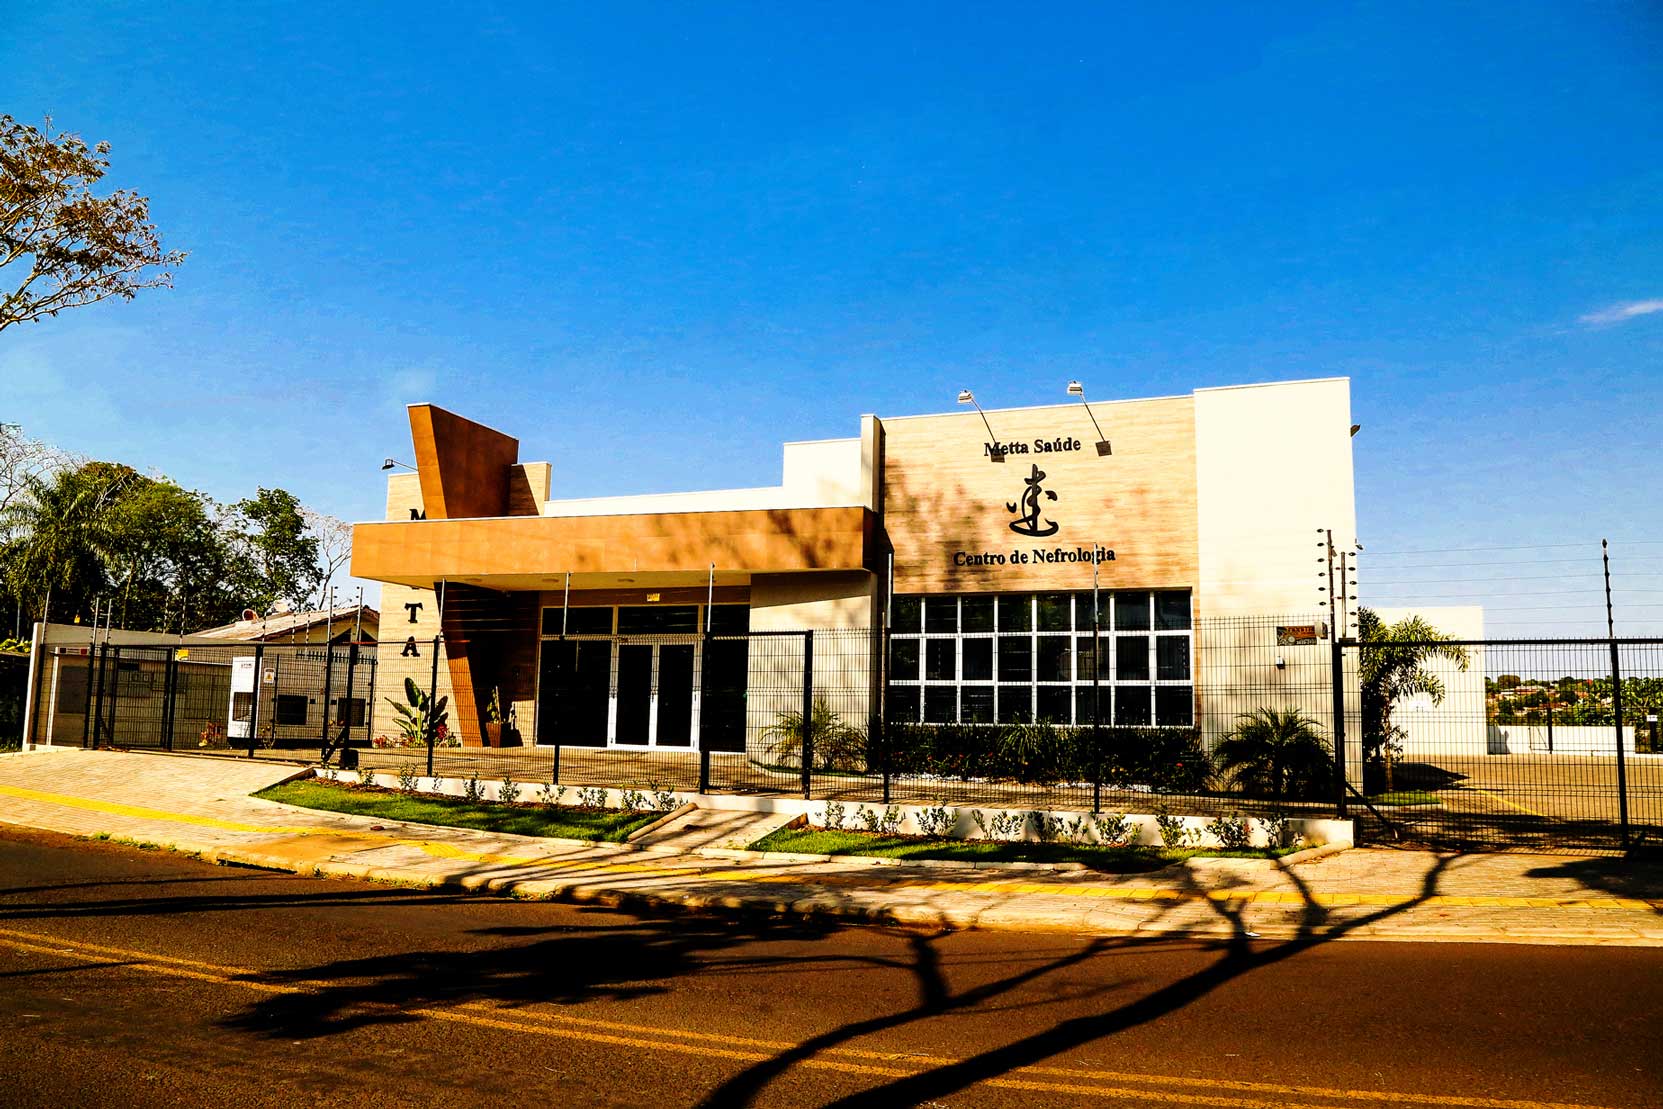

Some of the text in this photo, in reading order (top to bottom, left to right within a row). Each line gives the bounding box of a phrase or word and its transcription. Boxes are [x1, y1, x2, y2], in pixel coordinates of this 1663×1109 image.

[984, 437, 1082, 457] Metta Saúde
[953, 546, 1116, 566] Centro de Nefrologia
